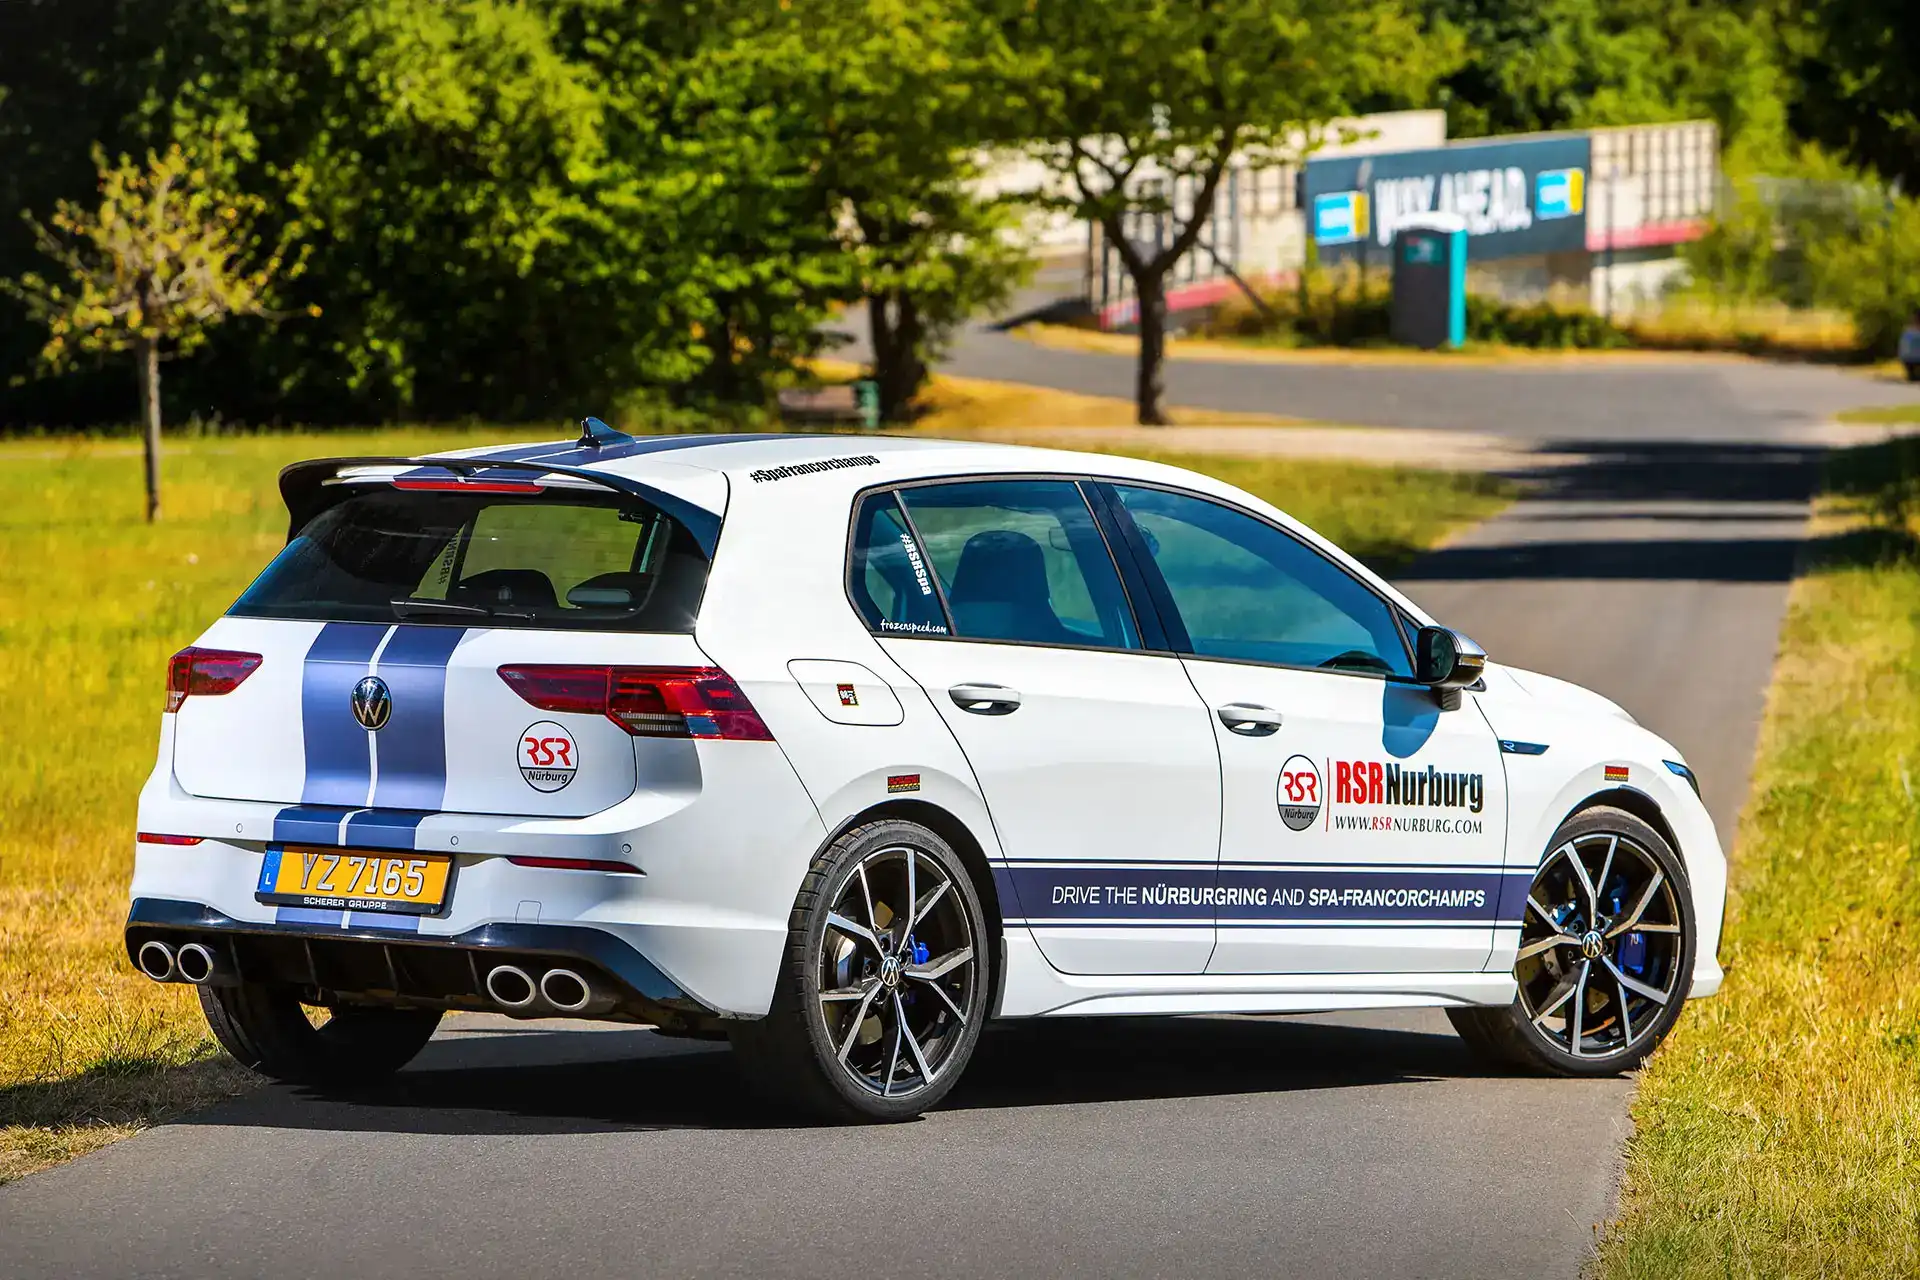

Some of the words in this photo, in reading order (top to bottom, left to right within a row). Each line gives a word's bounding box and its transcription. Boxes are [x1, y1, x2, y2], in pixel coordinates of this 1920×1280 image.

[749, 455, 881, 483] #SpaFrancorchamps
[900, 533, 932, 596] #RSRSpa
[880, 619, 947, 634] frozenspeed.com
[524, 737, 572, 767] RSR
[527, 770, 568, 784] Nürburg
[1283, 771, 1317, 802] RSR
[1284, 808, 1315, 822] Nürburg
[1335, 815, 1483, 835] WWW.RSRNURBURG.COM
[264, 873, 272, 885] L
[300, 852, 341, 891] YZ
[347, 856, 428, 897] 7165
[303, 896, 346, 908] SCHERER
[348, 898, 388, 910] GRUPPE
[1052, 886, 1101, 905] DRIVE
[1105, 886, 1138, 905] THE
[1141, 883, 1267, 906] NÜRBURGRING
[1271, 888, 1305, 906] AND
[1308, 888, 1486, 908] SPA-FRANCORCHAMPS
